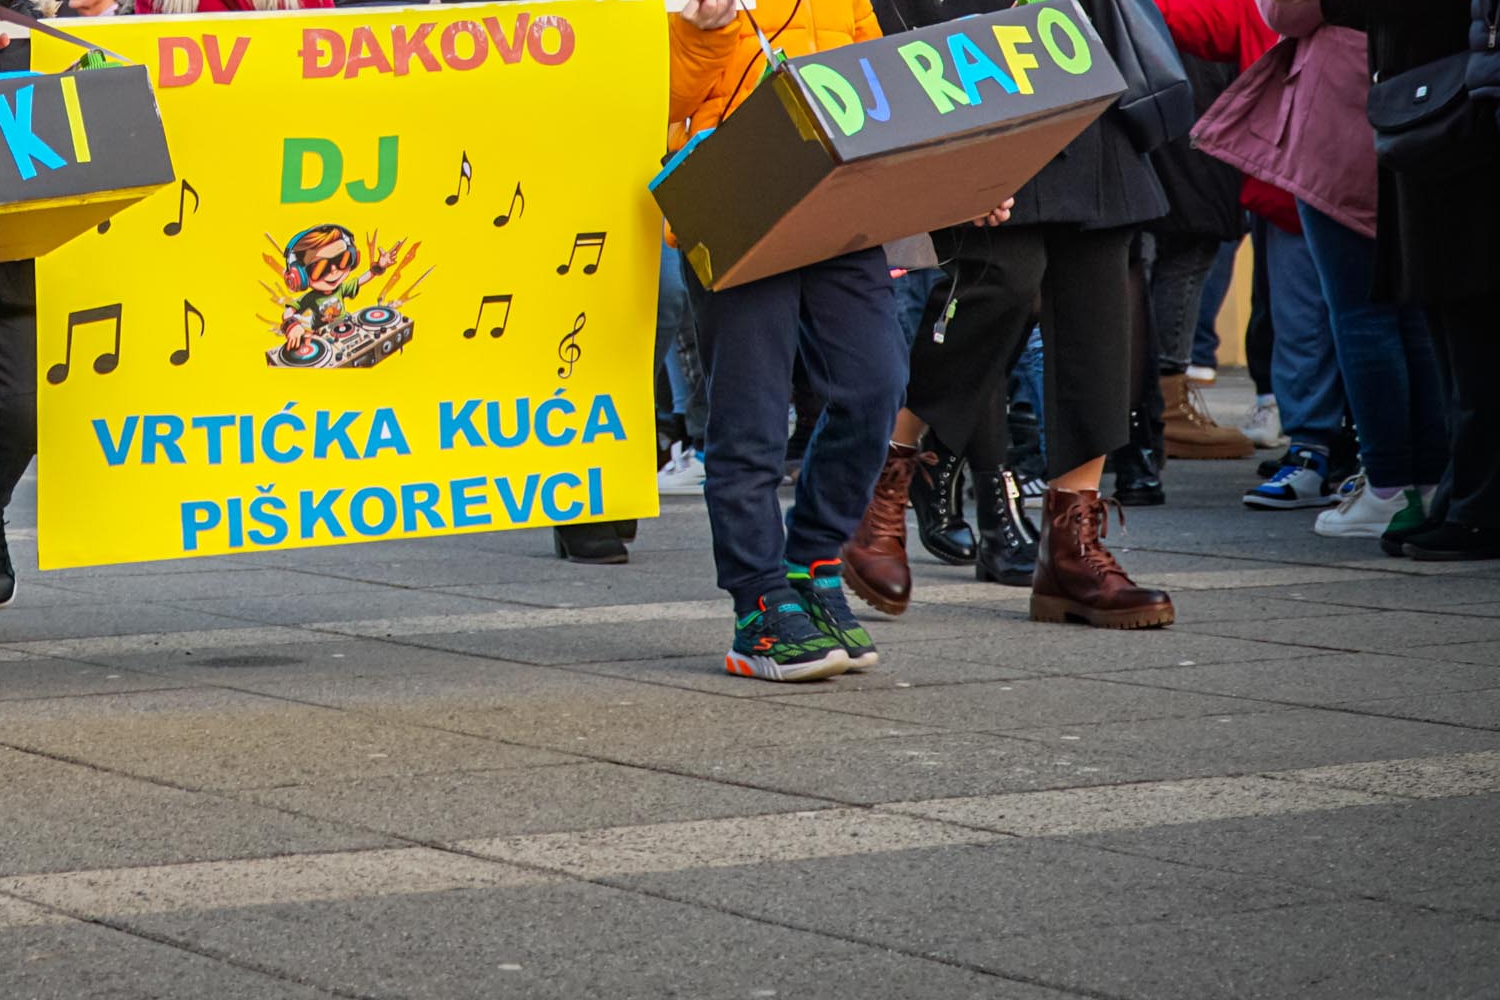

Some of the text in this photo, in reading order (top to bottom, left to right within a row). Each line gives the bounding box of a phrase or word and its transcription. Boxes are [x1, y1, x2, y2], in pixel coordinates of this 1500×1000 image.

[157, 12, 576, 88] DV ĐAKOVO
[799, 7, 1093, 137] DJ RAFO
[280, 135, 399, 204] DJ
[92, 388, 627, 466] VRTIĆKA KUĆA
[180, 466, 604, 551] PIŠKOREVCI
